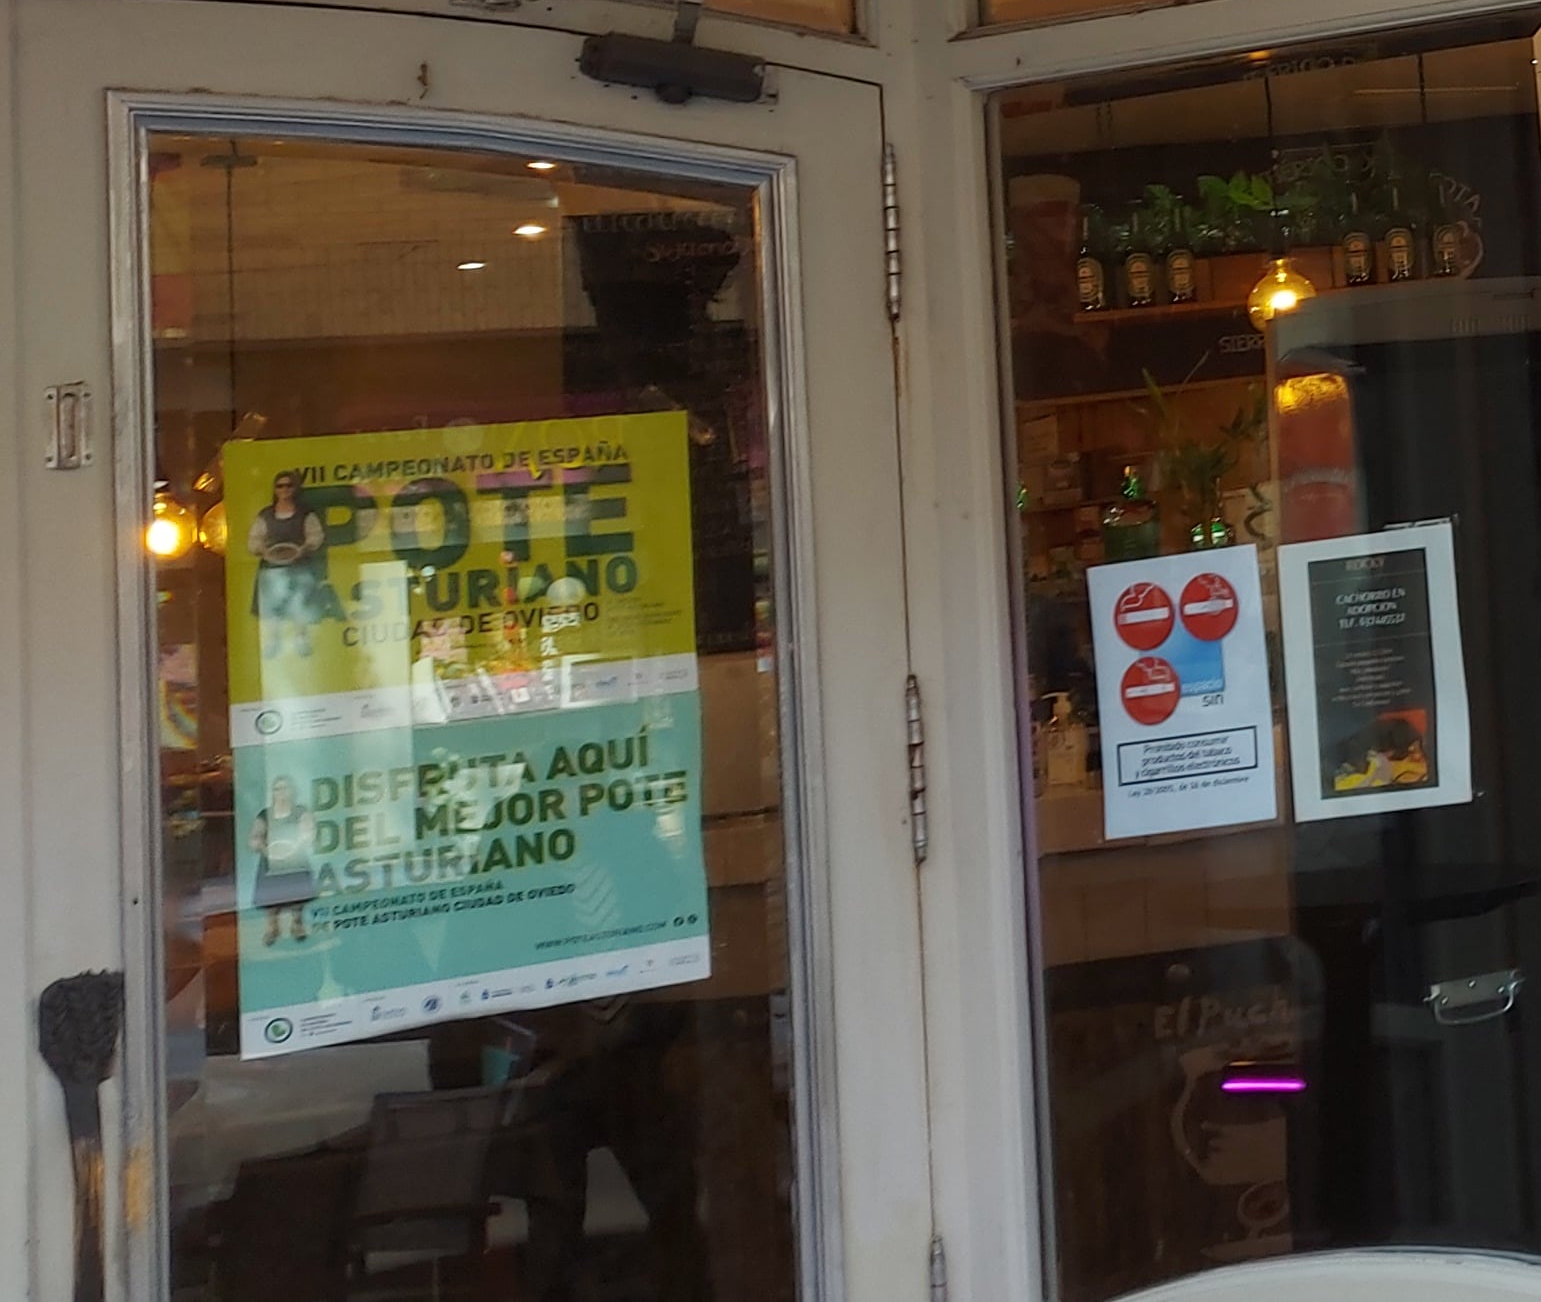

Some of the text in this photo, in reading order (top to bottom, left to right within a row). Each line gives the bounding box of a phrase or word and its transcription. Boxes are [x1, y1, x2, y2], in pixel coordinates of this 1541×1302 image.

[298, 440, 629, 484] VII CAMPEONATO DE ESPAÑA
[302, 464, 634, 570] POTE
[313, 555, 638, 623] ASTURIANO
[461, 611, 495, 635] DE
[546, 726, 649, 781] AQUÍ
[314, 770, 688, 855] DEL MEJOR POTE
[315, 828, 576, 895] ASTURIANO
[332, 891, 427, 916] CAMPEONATO
[428, 888, 448, 903] DE
[450, 879, 504, 897] ESPAÑA
[333, 913, 370, 930] POTE
[371, 903, 451, 925] ASTURIANO
[527, 882, 576, 903] OVIEDO
